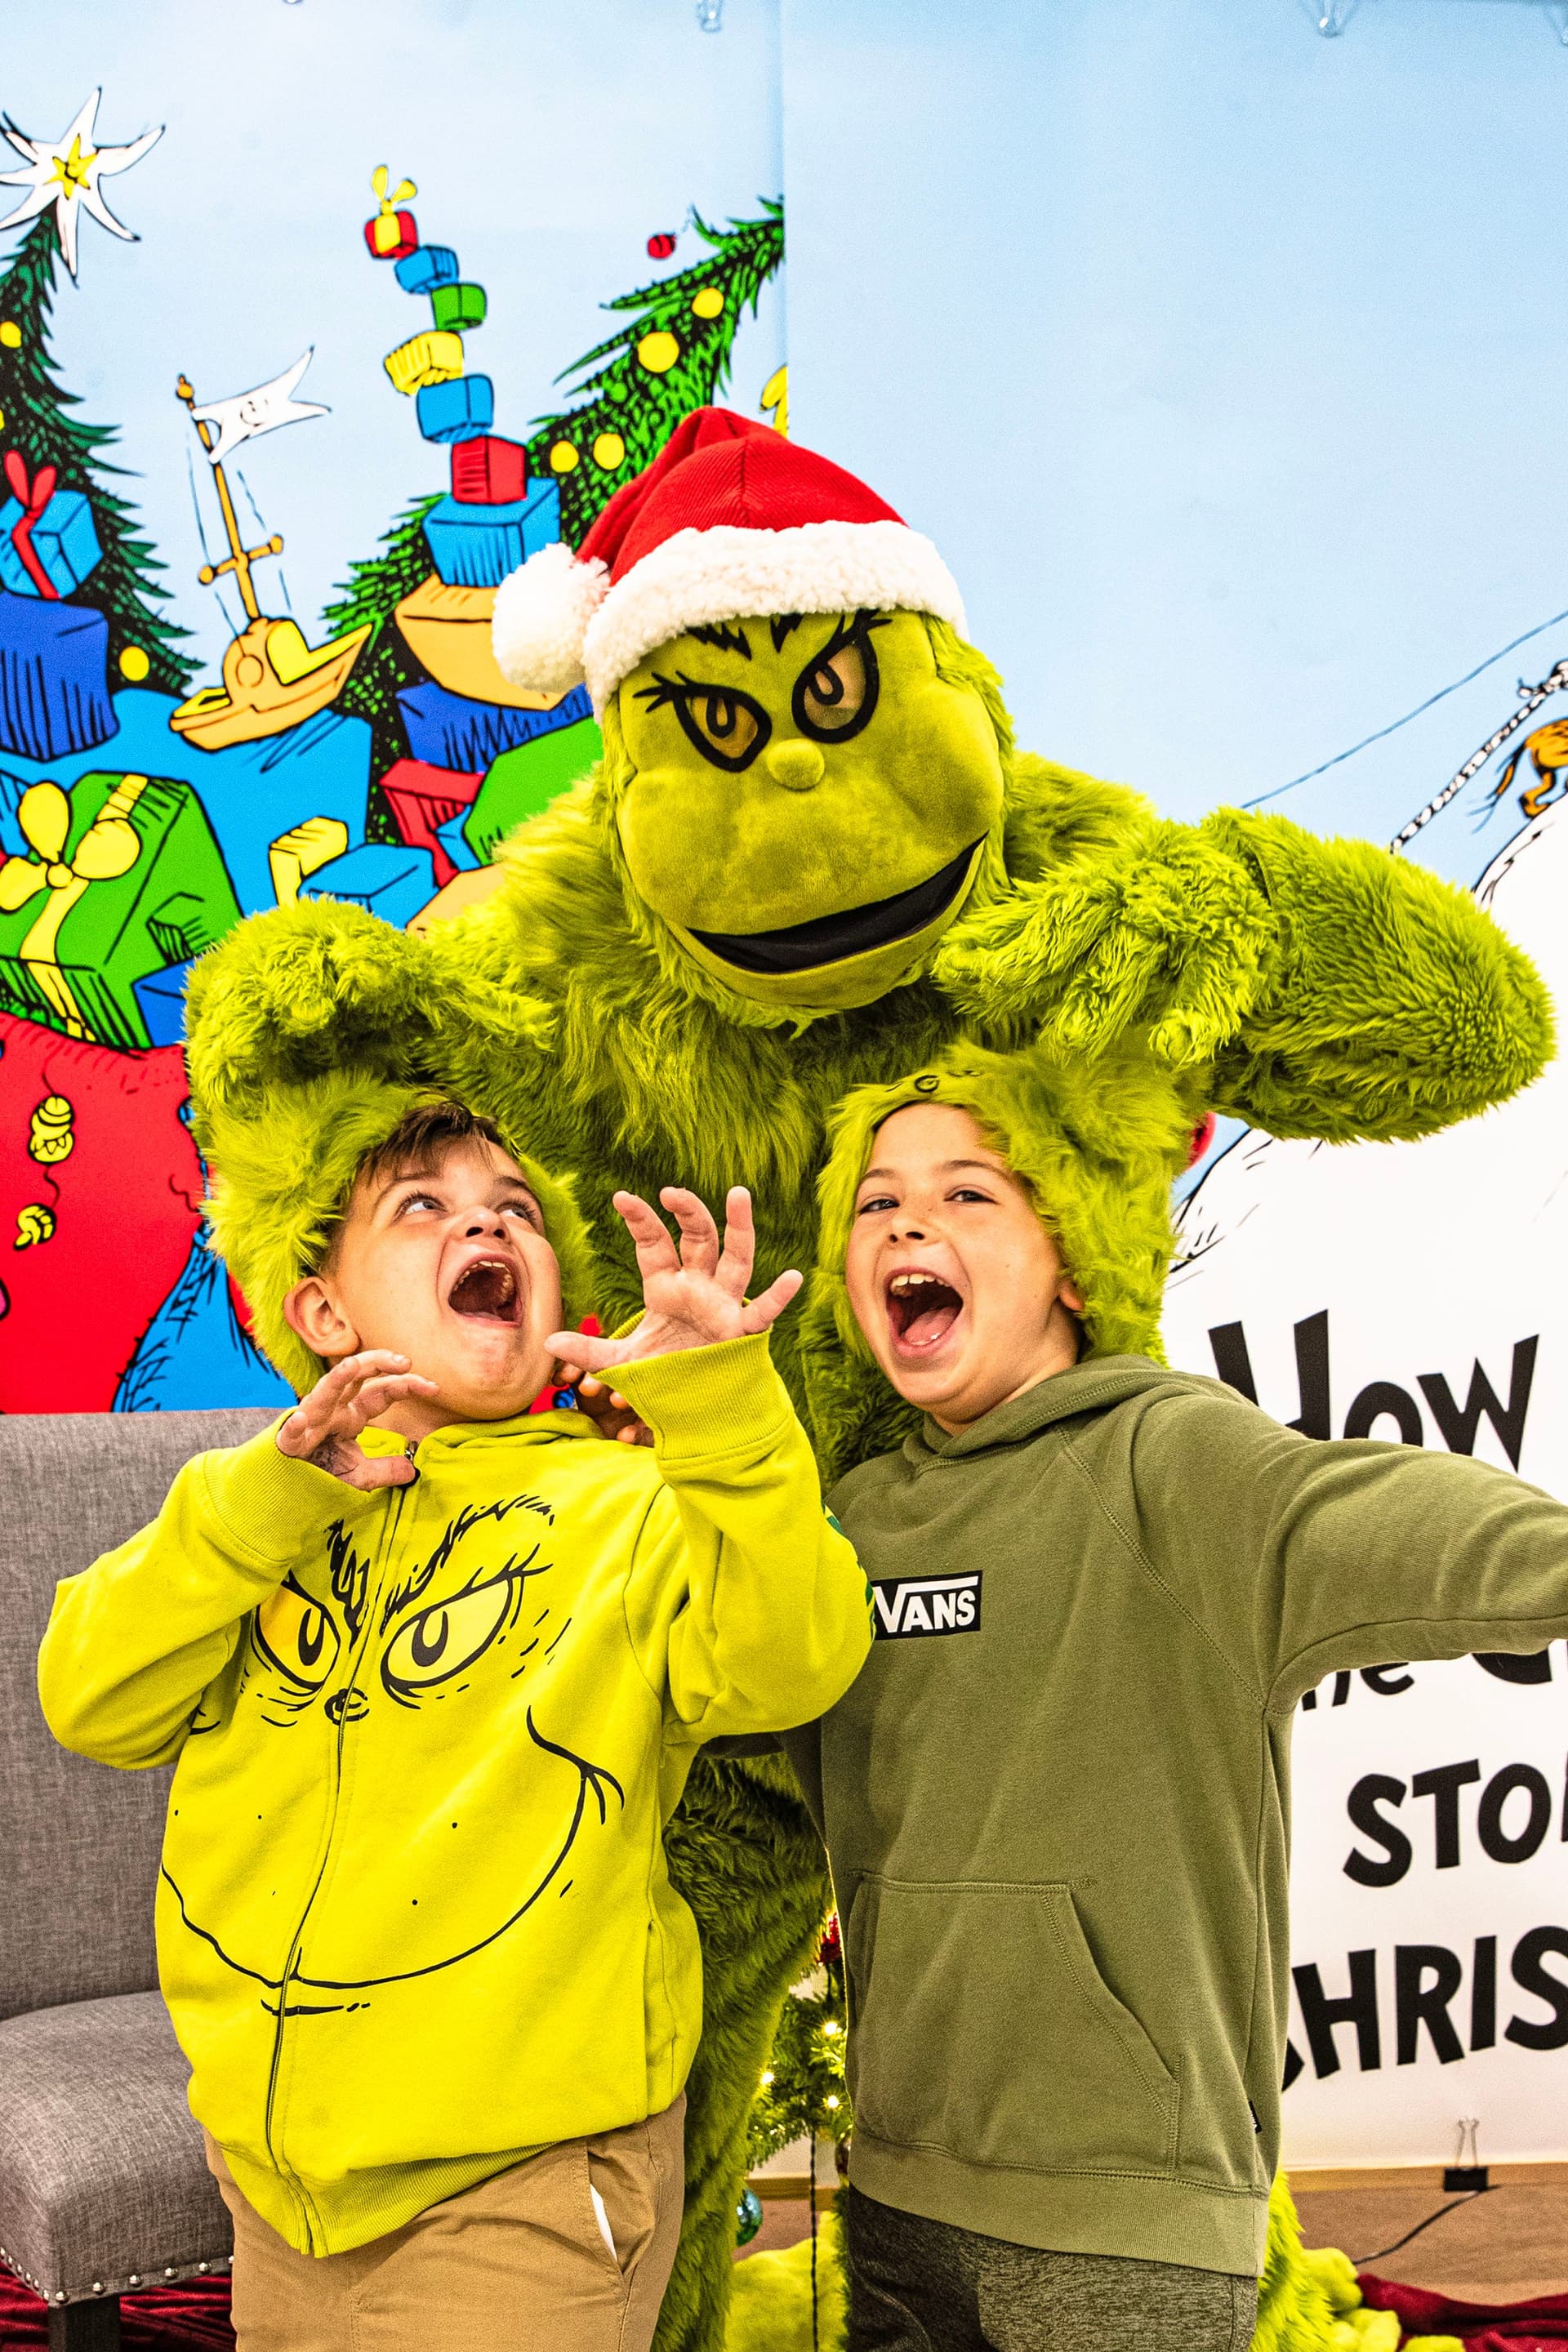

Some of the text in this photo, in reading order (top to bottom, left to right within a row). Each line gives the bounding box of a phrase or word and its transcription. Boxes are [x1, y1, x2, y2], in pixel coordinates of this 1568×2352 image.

[1208, 1308, 1539, 1473] How
[872, 1576, 979, 1633] VANS
[1343, 1751, 1568, 1888] STO
[1281, 1926, 1568, 2093] HRIS
